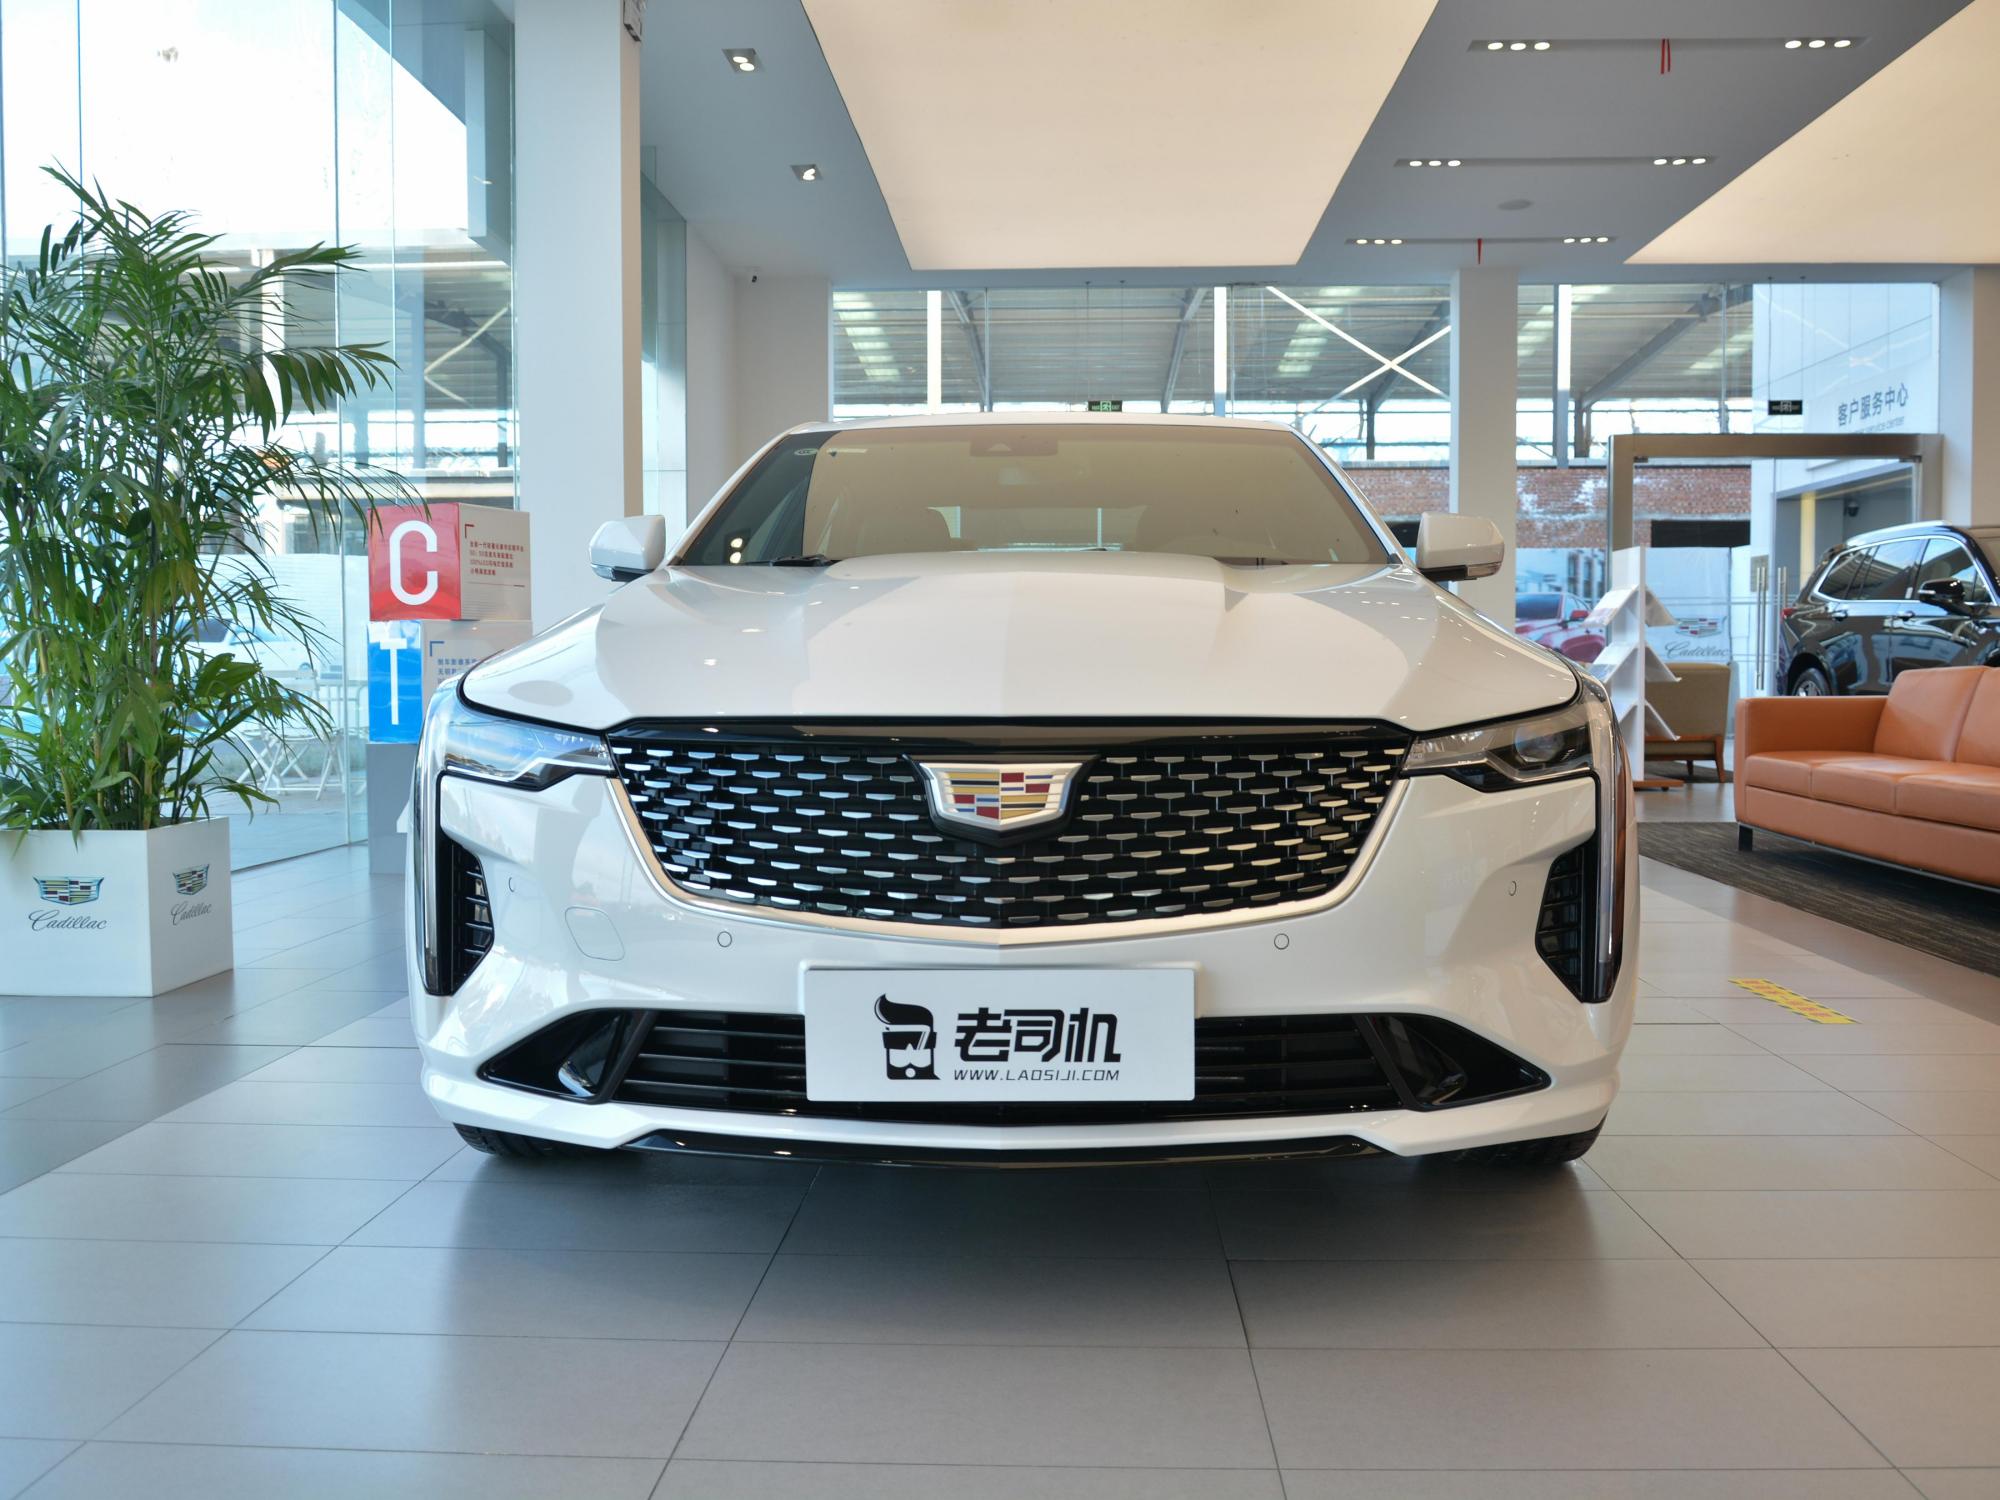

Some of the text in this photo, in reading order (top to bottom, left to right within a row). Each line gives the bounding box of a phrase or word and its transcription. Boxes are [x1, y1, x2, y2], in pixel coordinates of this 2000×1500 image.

[1837, 382, 1909, 427] 客户服务中心
[389, 520, 438, 606] C
[1664, 640, 1729, 658] Cadillac
[380, 638, 407, 725] T
[28, 909, 108, 932] Cadillac
[170, 902, 212, 926] Cadillac
[954, 1007, 1121, 1063] 老司机
[954, 1069, 1120, 1081] WWW.LAOSIJI.COM
